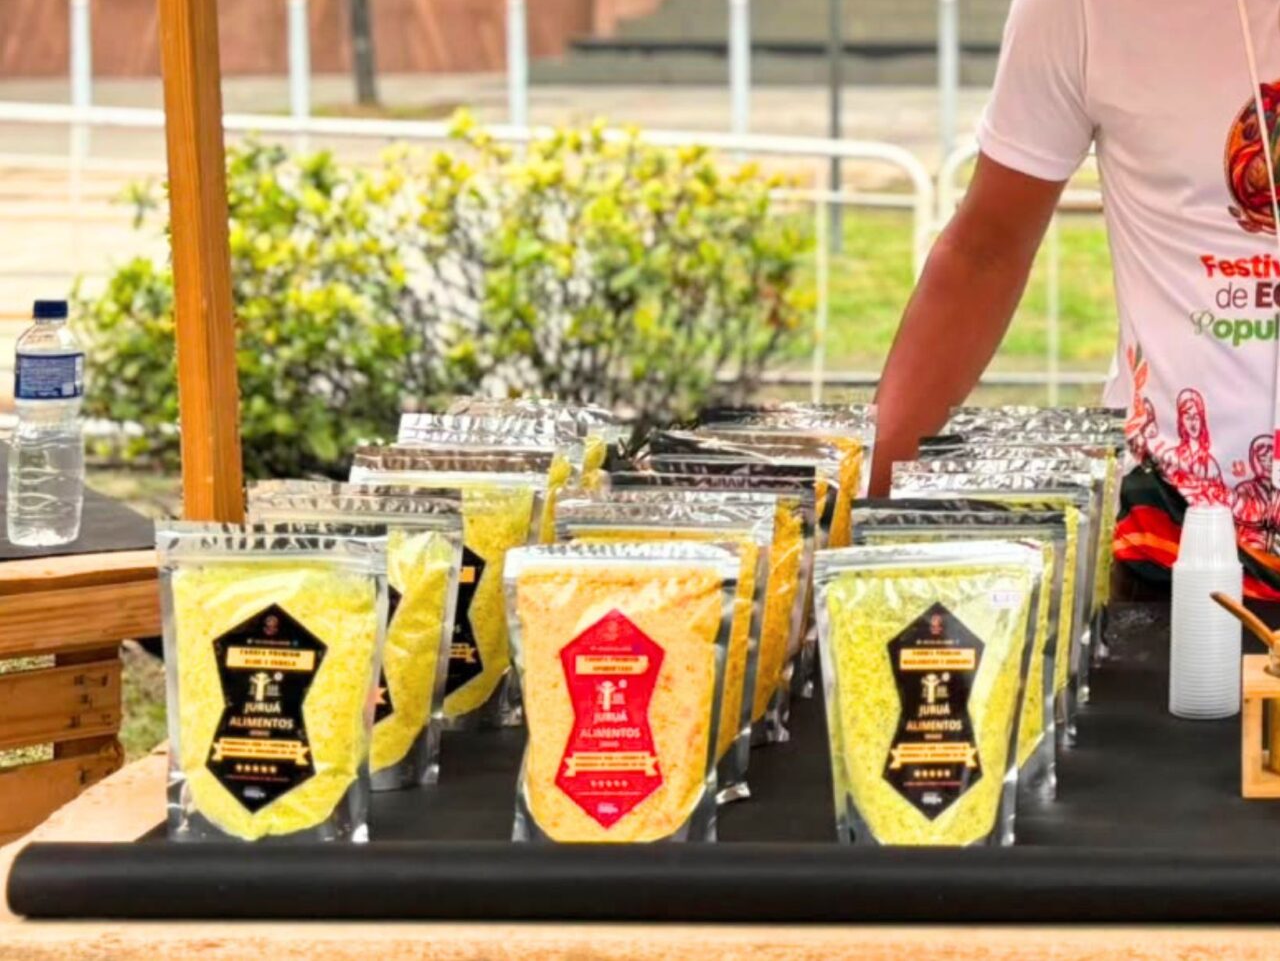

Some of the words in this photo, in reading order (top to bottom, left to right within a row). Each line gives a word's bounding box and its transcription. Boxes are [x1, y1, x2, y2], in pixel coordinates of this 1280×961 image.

[1215, 281, 1248, 309] de
[1190, 310, 1280, 346] Popul
[244, 701, 281, 716] JURUÁ
[229, 716, 294, 729] ALIMENTOS
[905, 720, 962, 731] ALIMENTOS
